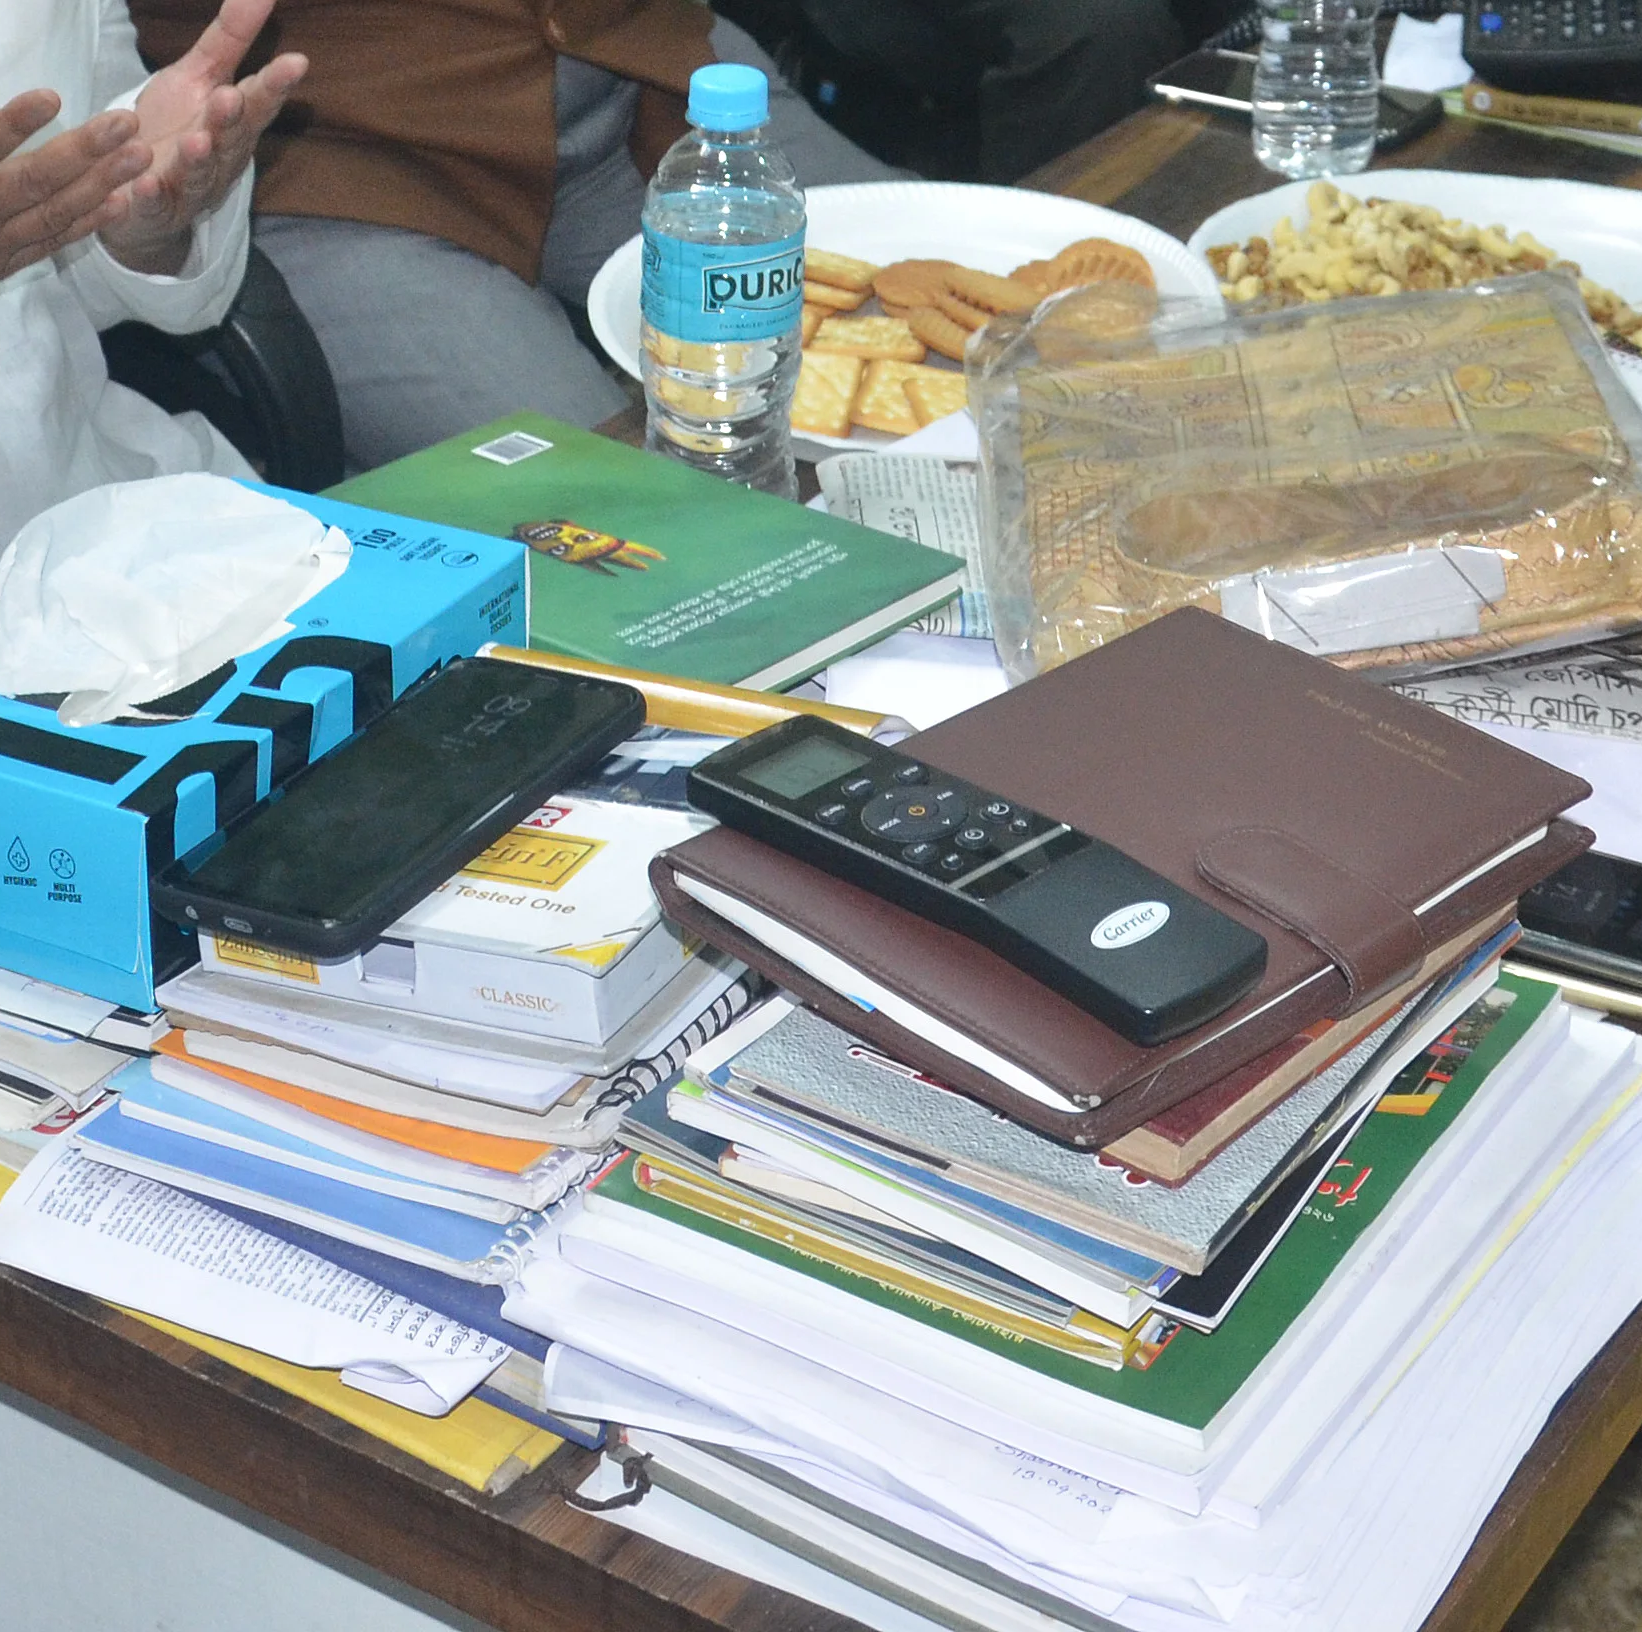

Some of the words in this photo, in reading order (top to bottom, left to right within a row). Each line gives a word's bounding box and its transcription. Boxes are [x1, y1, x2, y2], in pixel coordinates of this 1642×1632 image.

[354, 528, 396, 550] 100
[3, 875, 38, 887] HYGIENIC
[53, 882, 76, 893] MULTI
[47, 892, 82, 904] PURPOSE
[455, 885, 527, 907] Tested
[530, 898, 577, 916] One
[1103, 908, 1155, 941] Carrier
[480, 986, 556, 1013] CLASSIC
